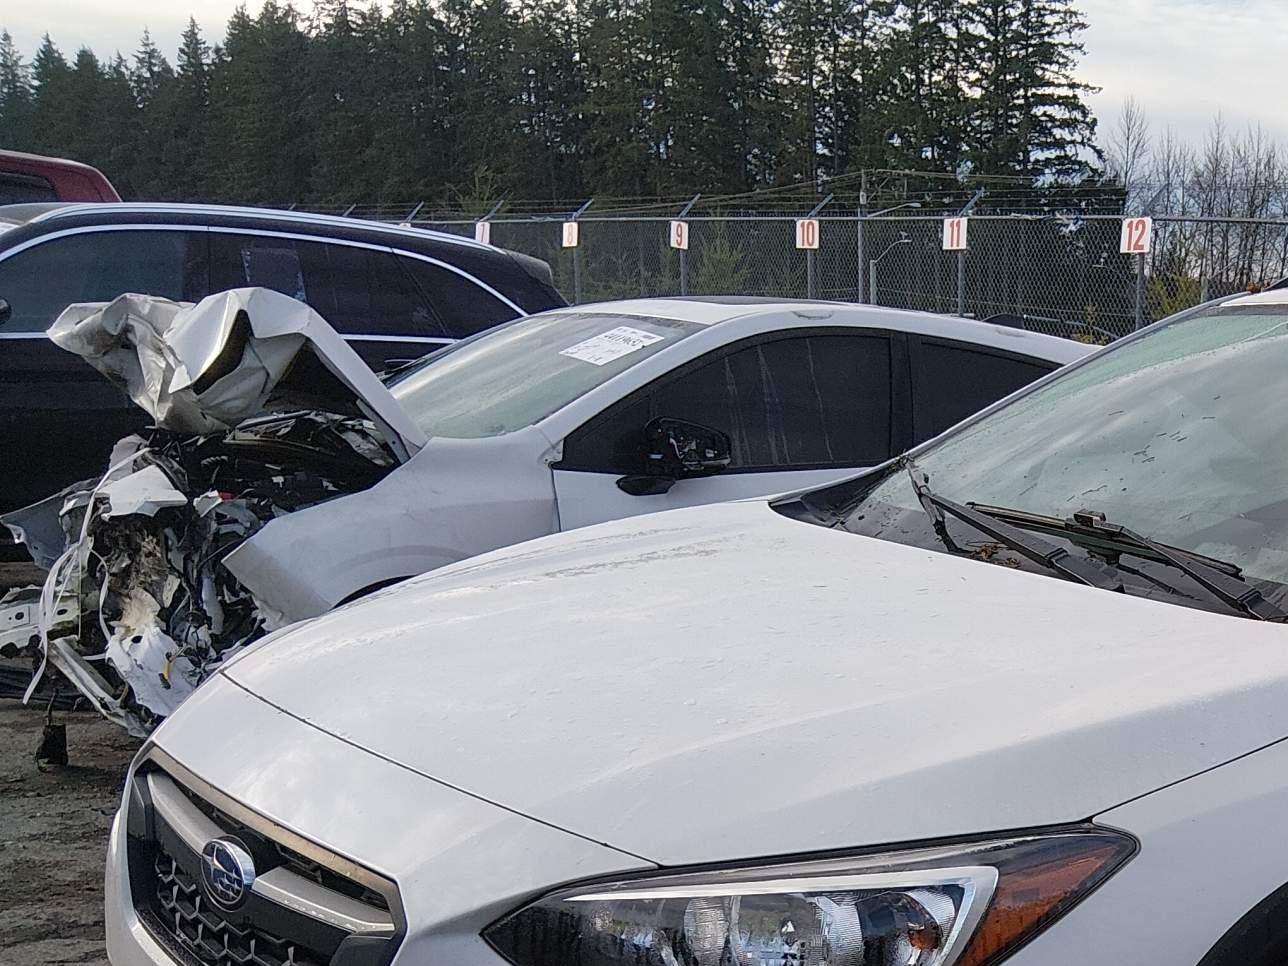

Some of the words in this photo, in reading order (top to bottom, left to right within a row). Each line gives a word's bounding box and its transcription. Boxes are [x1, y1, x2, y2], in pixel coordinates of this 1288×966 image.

[675, 223, 683, 247] 9
[800, 221, 815, 247] 10
[949, 219, 961, 248] 11
[1126, 219, 1147, 251] 12
